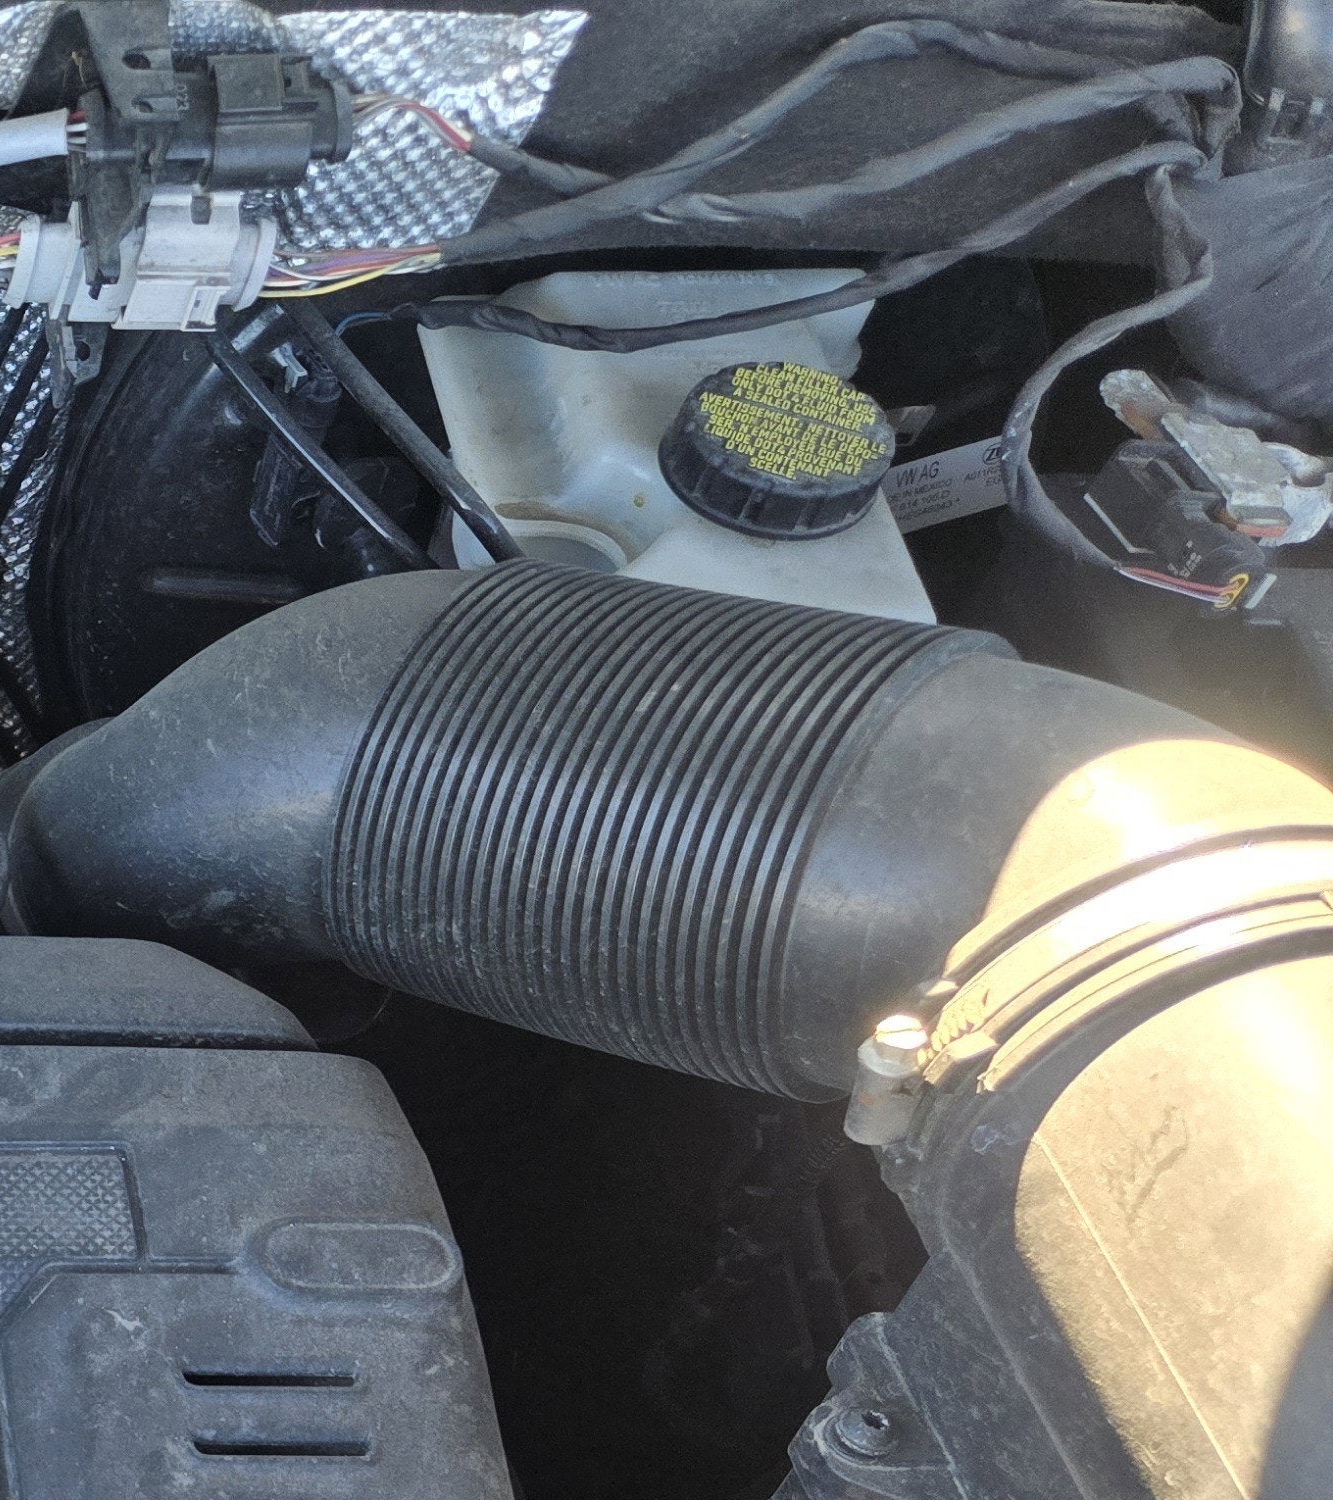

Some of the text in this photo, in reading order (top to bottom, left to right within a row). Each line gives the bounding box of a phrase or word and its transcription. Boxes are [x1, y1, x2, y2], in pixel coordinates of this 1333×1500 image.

[735, 367, 781, 388] BEFORE
[756, 363, 864, 402] CLEAN FILLER CAP
[731, 376, 875, 426] ONLY DOT 4 FLUID FROM
[733, 387, 742, 396] A
[744, 390, 790, 410] SEALED
[759, 419, 798, 438] AVANT
[801, 431, 817, 443] DE
[820, 437, 836, 449] LE
[807, 423, 869, 448] NETTOYER
[871, 442, 886, 454] LE
[703, 423, 750, 444] LIQUIDE
[787, 446, 860, 476] PROVENANT
[725, 440, 829, 477] D'UN CONTENANT
[817, 445, 843, 461] QUE
[845, 454, 863, 467] DU
[916, 460, 942, 481] AG
